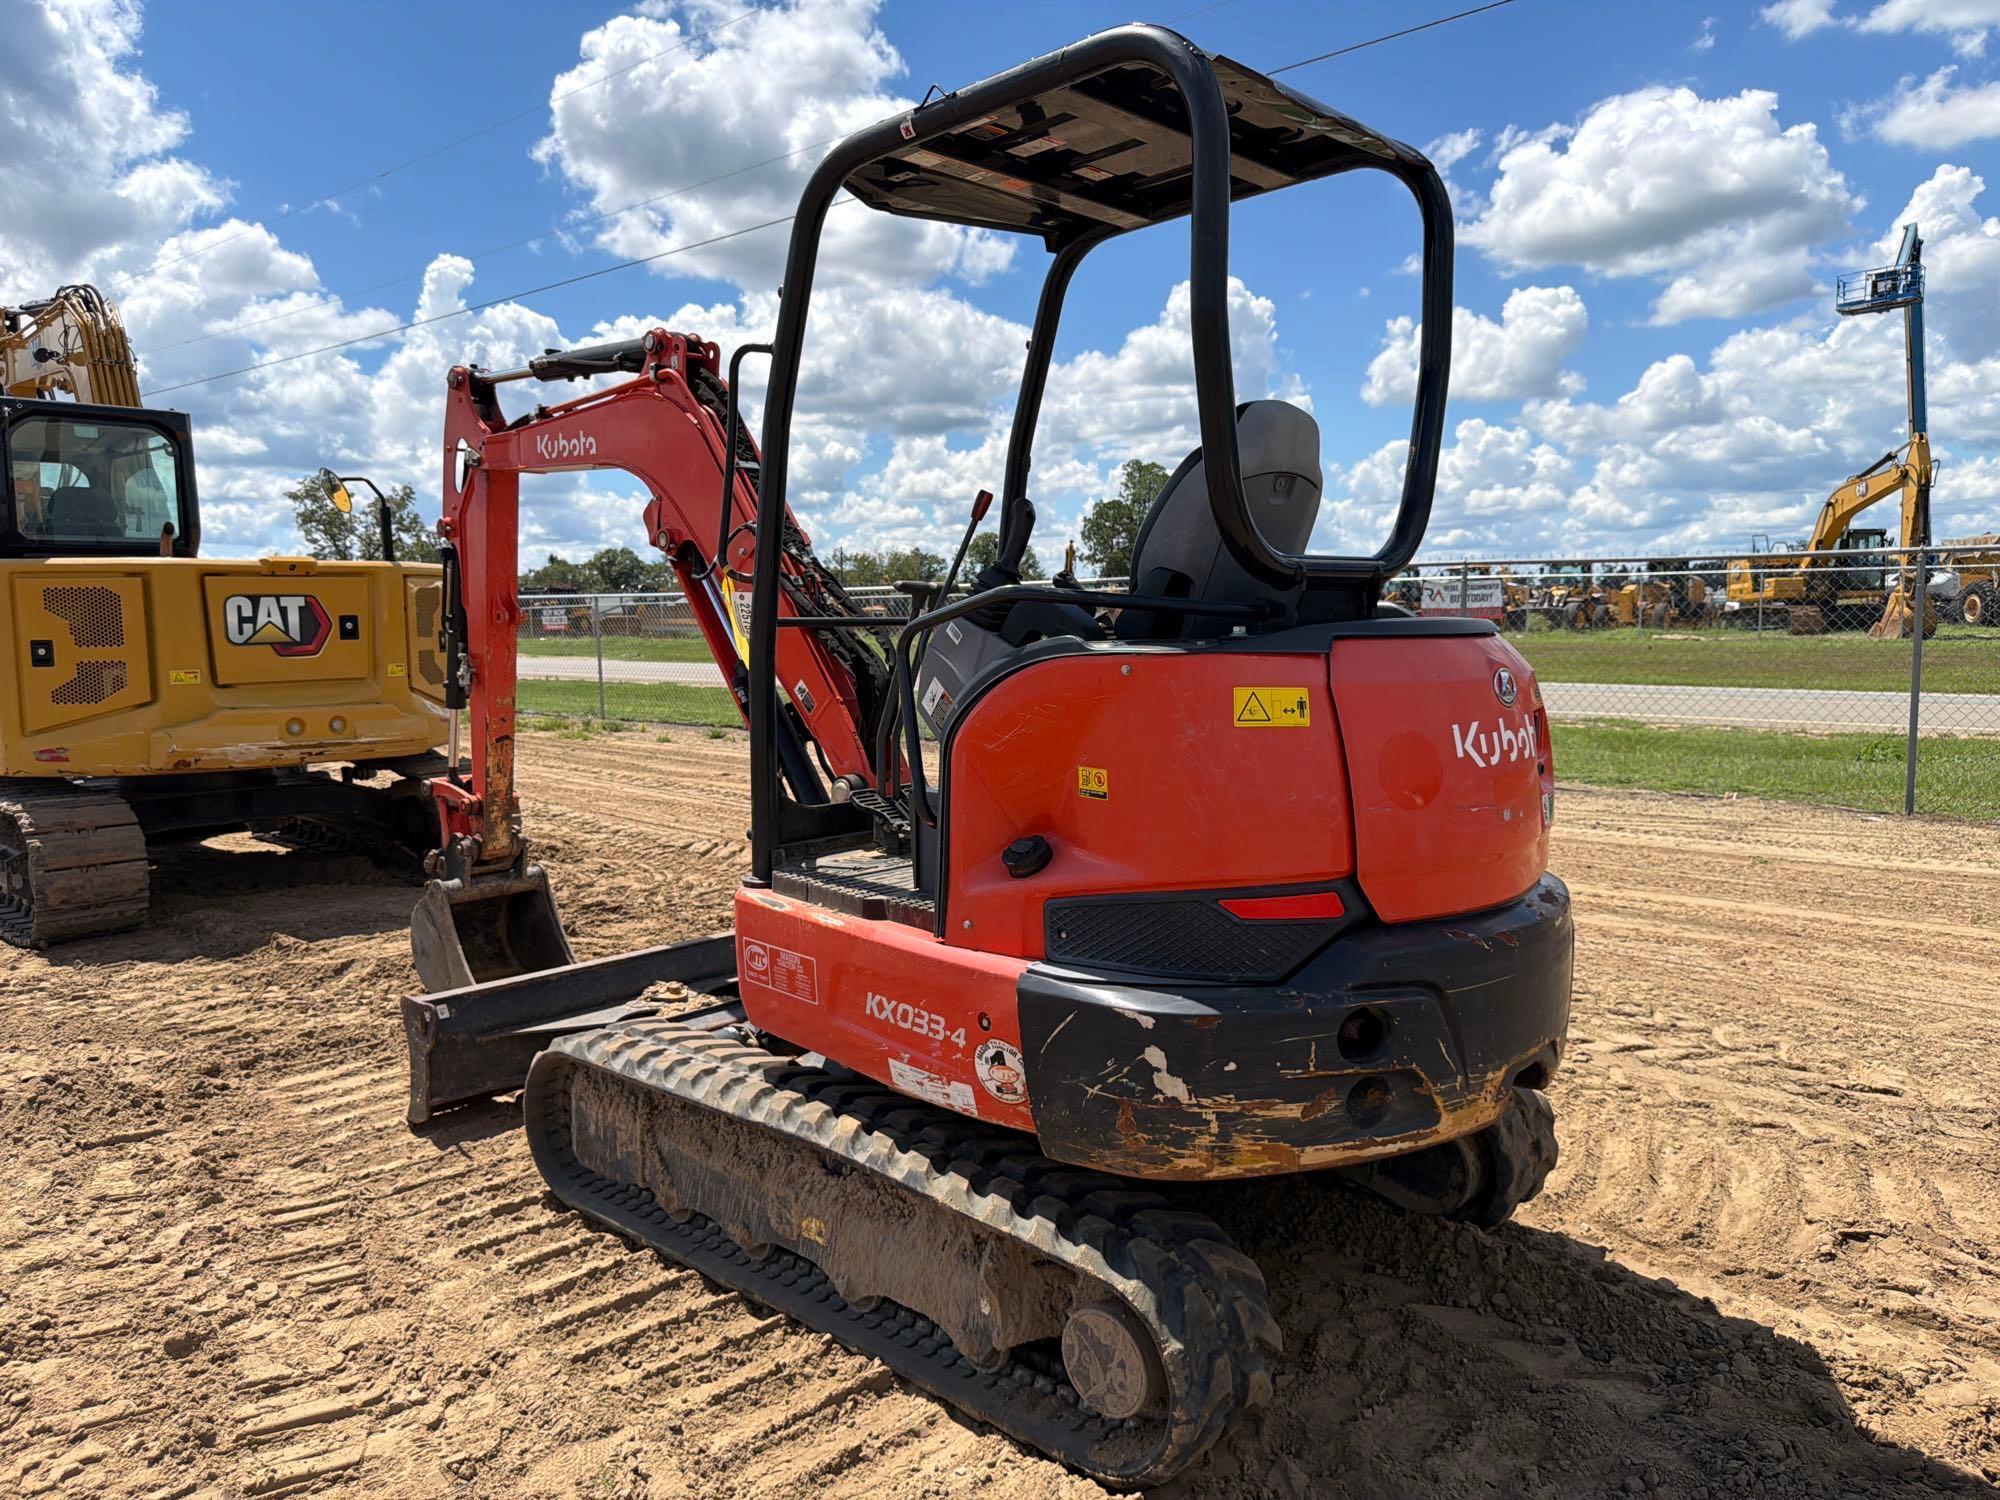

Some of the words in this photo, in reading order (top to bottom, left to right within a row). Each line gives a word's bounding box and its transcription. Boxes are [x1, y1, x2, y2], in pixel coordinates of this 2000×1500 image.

[536, 430, 597, 459] Kubota
[225, 595, 306, 645] CAT
[1452, 714, 1536, 768] Kubot
[866, 991, 967, 1048] KX033-4
